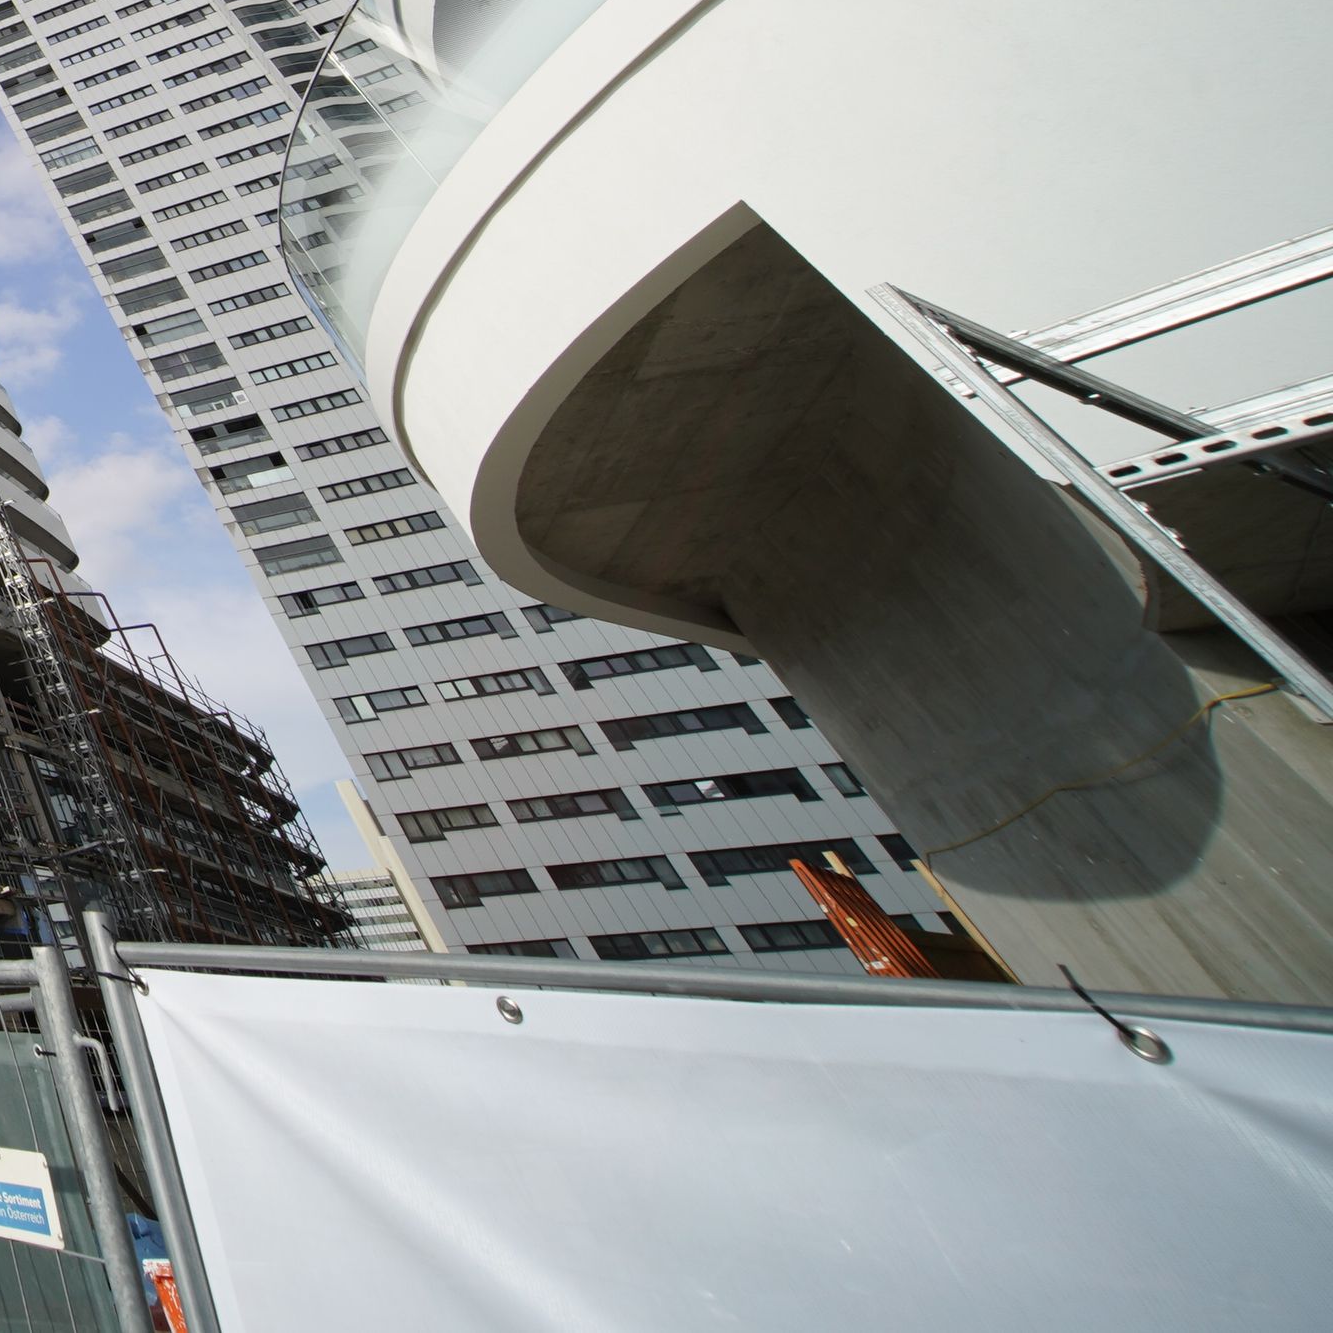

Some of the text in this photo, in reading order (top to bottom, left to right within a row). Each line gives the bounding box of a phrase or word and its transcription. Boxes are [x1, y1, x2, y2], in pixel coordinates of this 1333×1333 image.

[3, 1191, 41, 1209] Sortiment
[0, 1206, 6, 1217] in
[7, 1207, 45, 1225] Österreich
